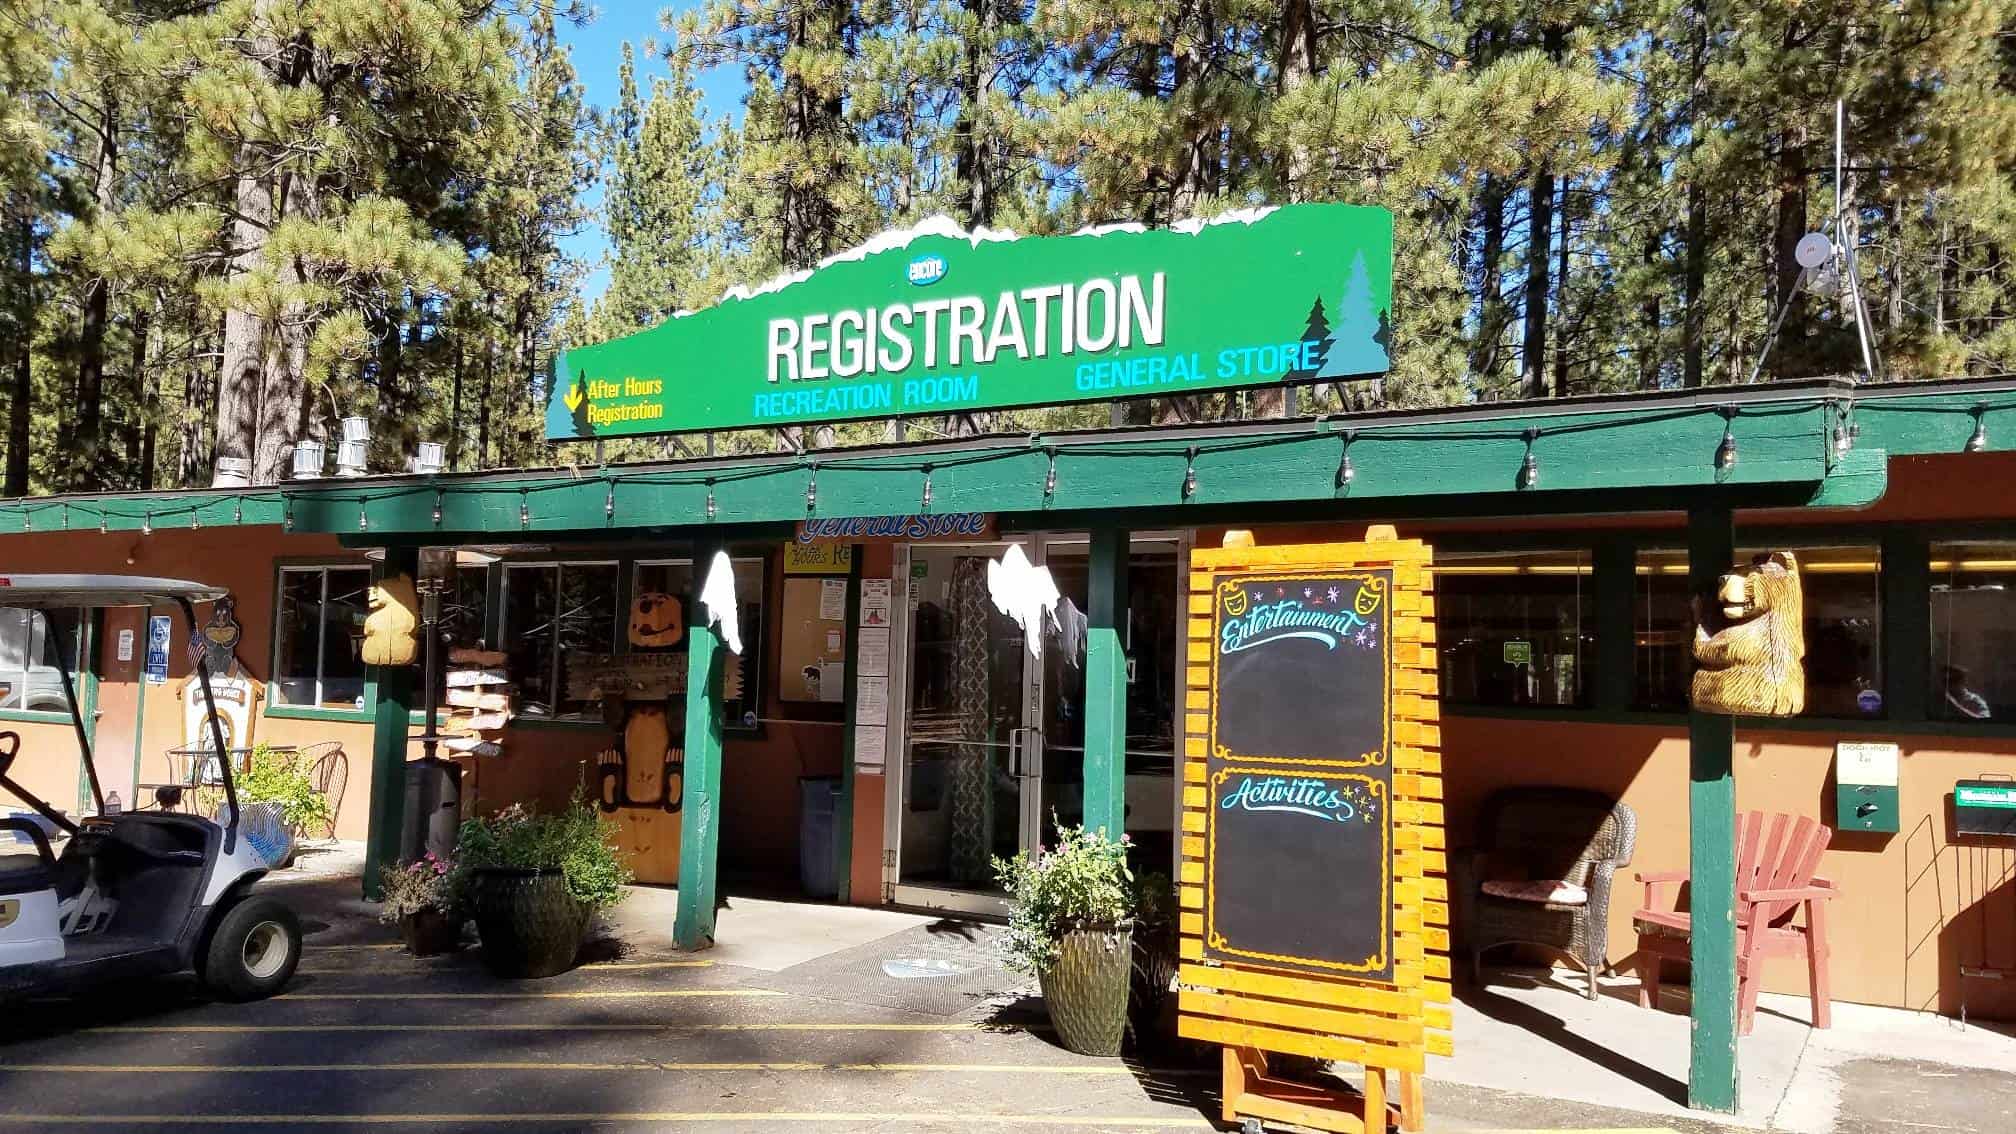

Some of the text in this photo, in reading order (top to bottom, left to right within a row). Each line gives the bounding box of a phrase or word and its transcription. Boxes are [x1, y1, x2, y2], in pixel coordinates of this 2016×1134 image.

[766, 271, 1165, 383] REGISTRATION
[1075, 340, 1320, 392] GENERAL STORE
[588, 378, 662, 398] After Hours
[753, 374, 978, 418] RECREATION ROOM
[587, 402, 662, 425] Registration
[800, 513, 986, 543] General Store
[1221, 600, 1367, 649] Entertainment
[1222, 777, 1352, 817] Activities
